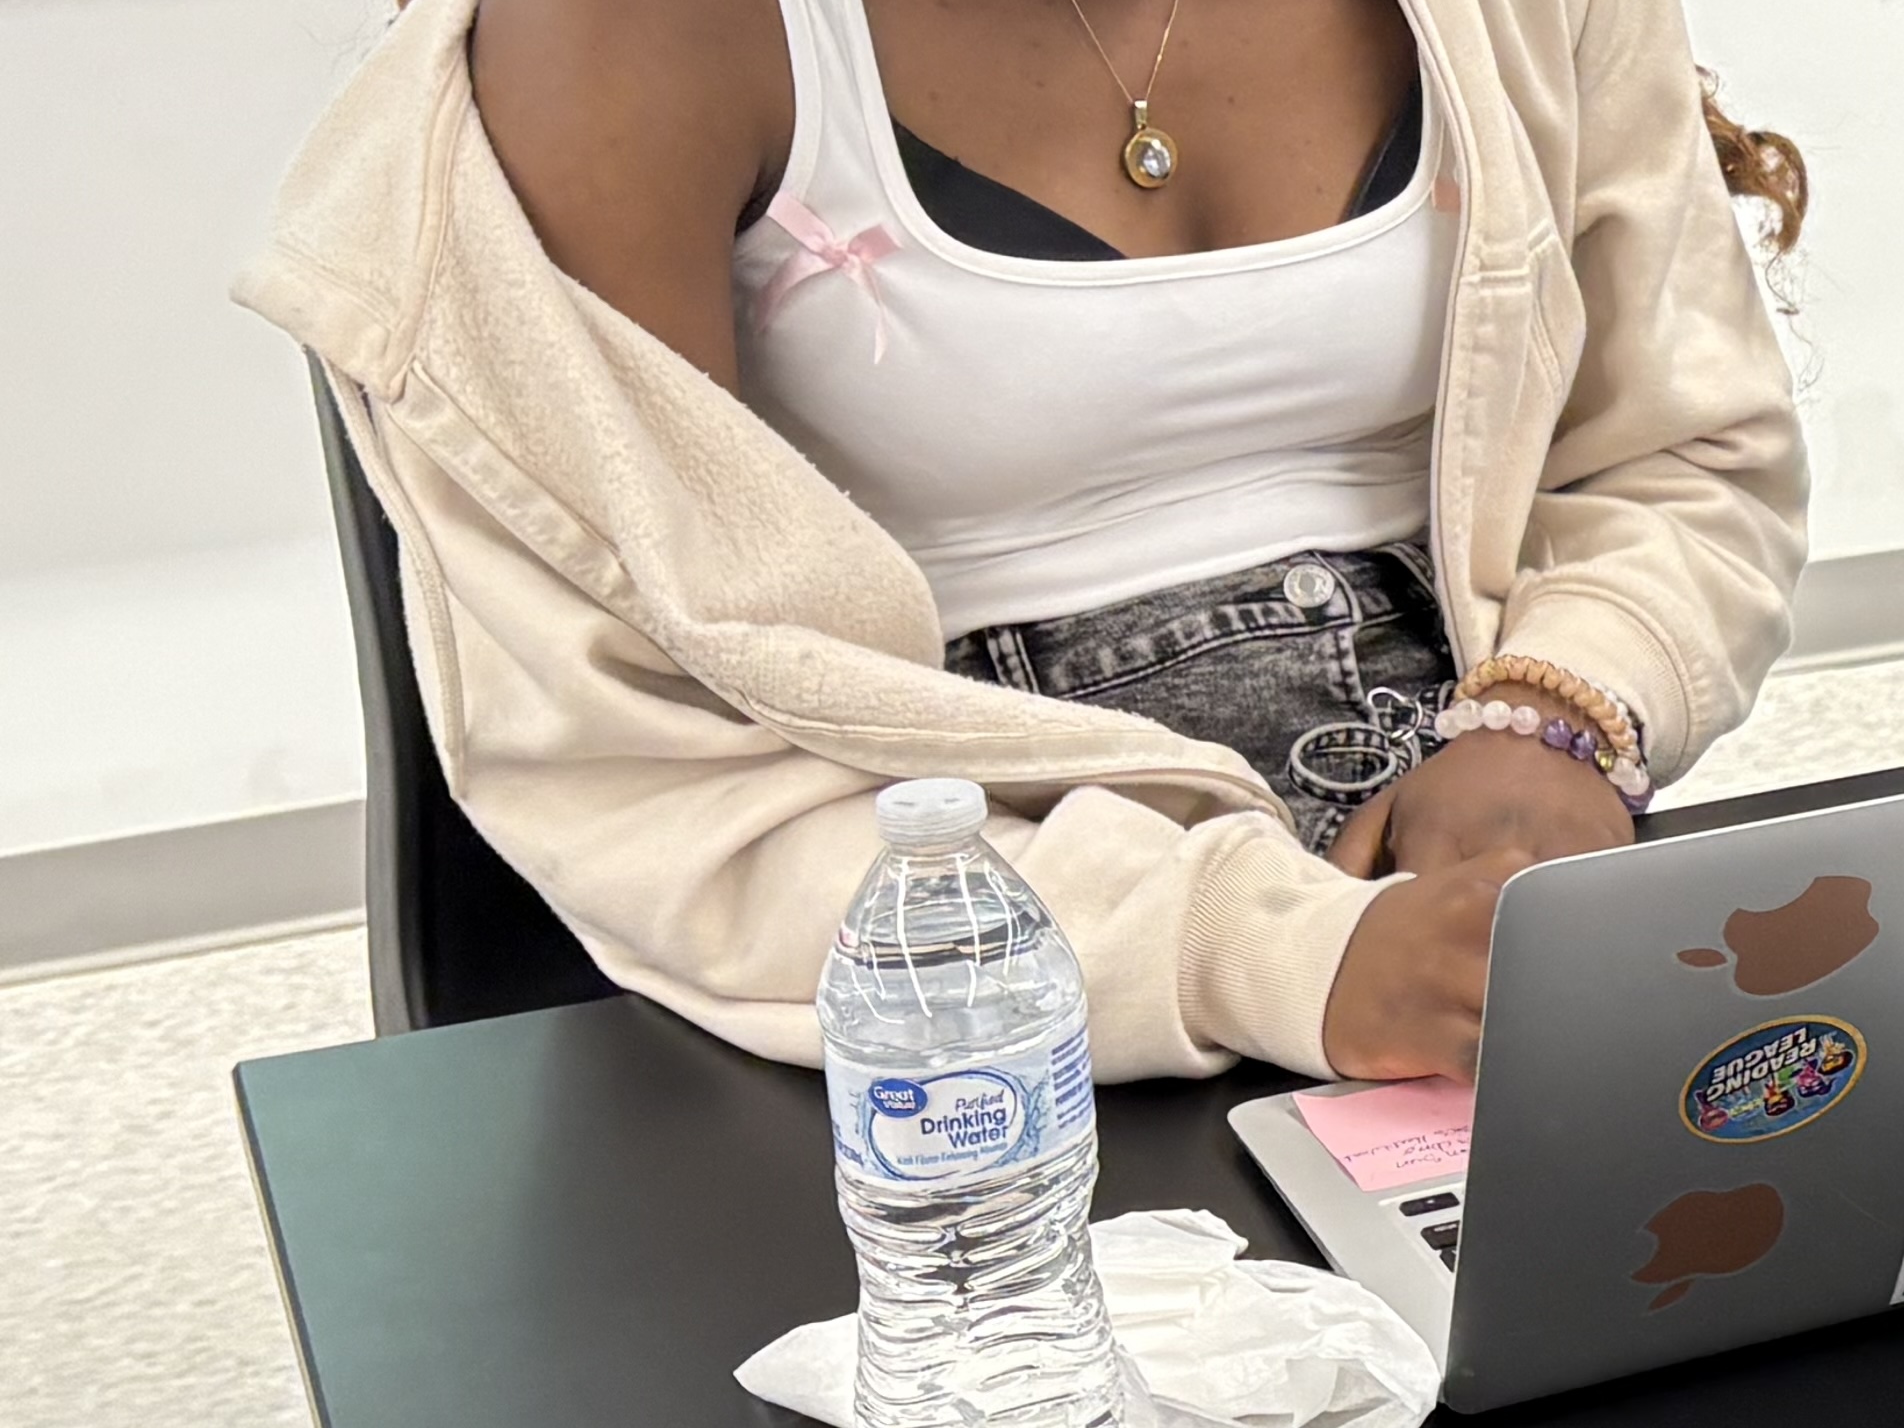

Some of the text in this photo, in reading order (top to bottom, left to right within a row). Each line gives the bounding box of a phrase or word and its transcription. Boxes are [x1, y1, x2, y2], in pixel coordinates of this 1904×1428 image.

[1706, 1037, 1816, 1103] READING
[1711, 1026, 1807, 1083] LEAGUE
[921, 1108, 1007, 1135] Drinking
[948, 1125, 1009, 1149] Water
